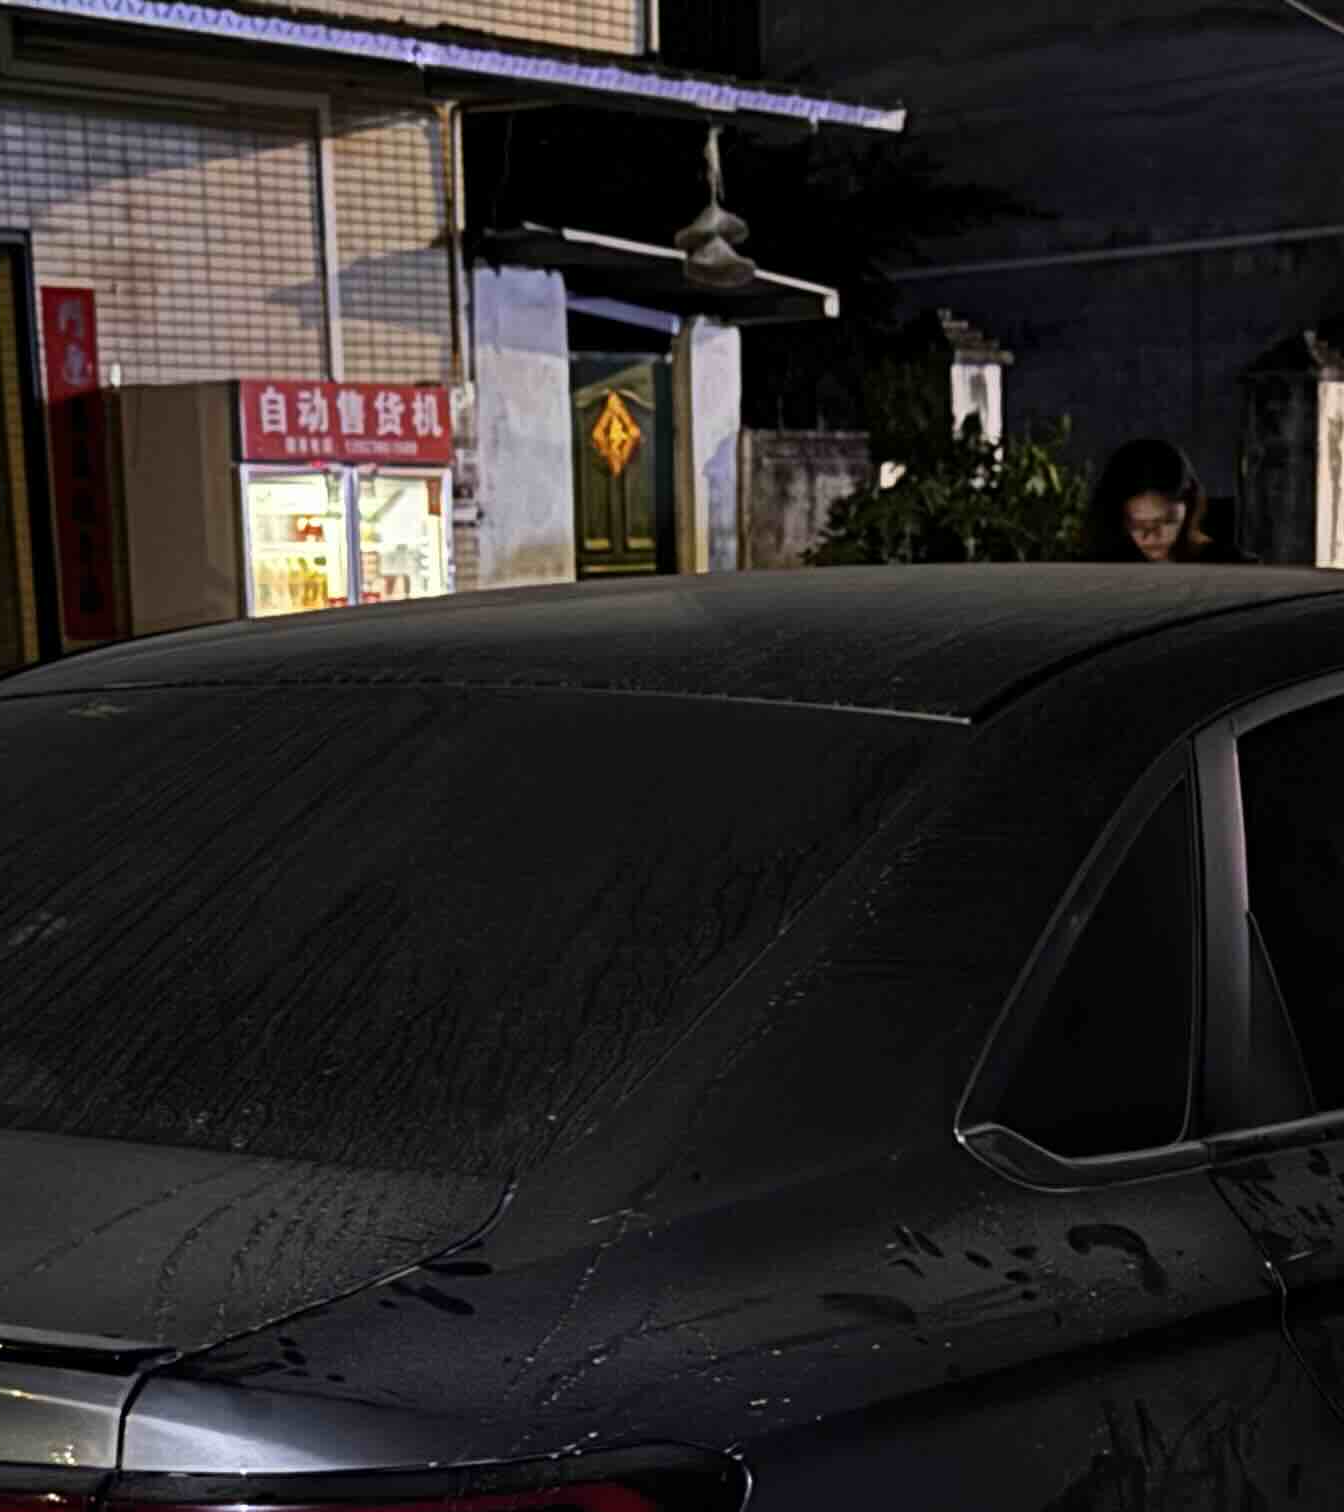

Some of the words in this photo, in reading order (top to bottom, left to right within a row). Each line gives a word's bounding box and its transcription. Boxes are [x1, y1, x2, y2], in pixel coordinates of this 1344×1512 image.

[260, 386, 443, 437] 自动售货机
